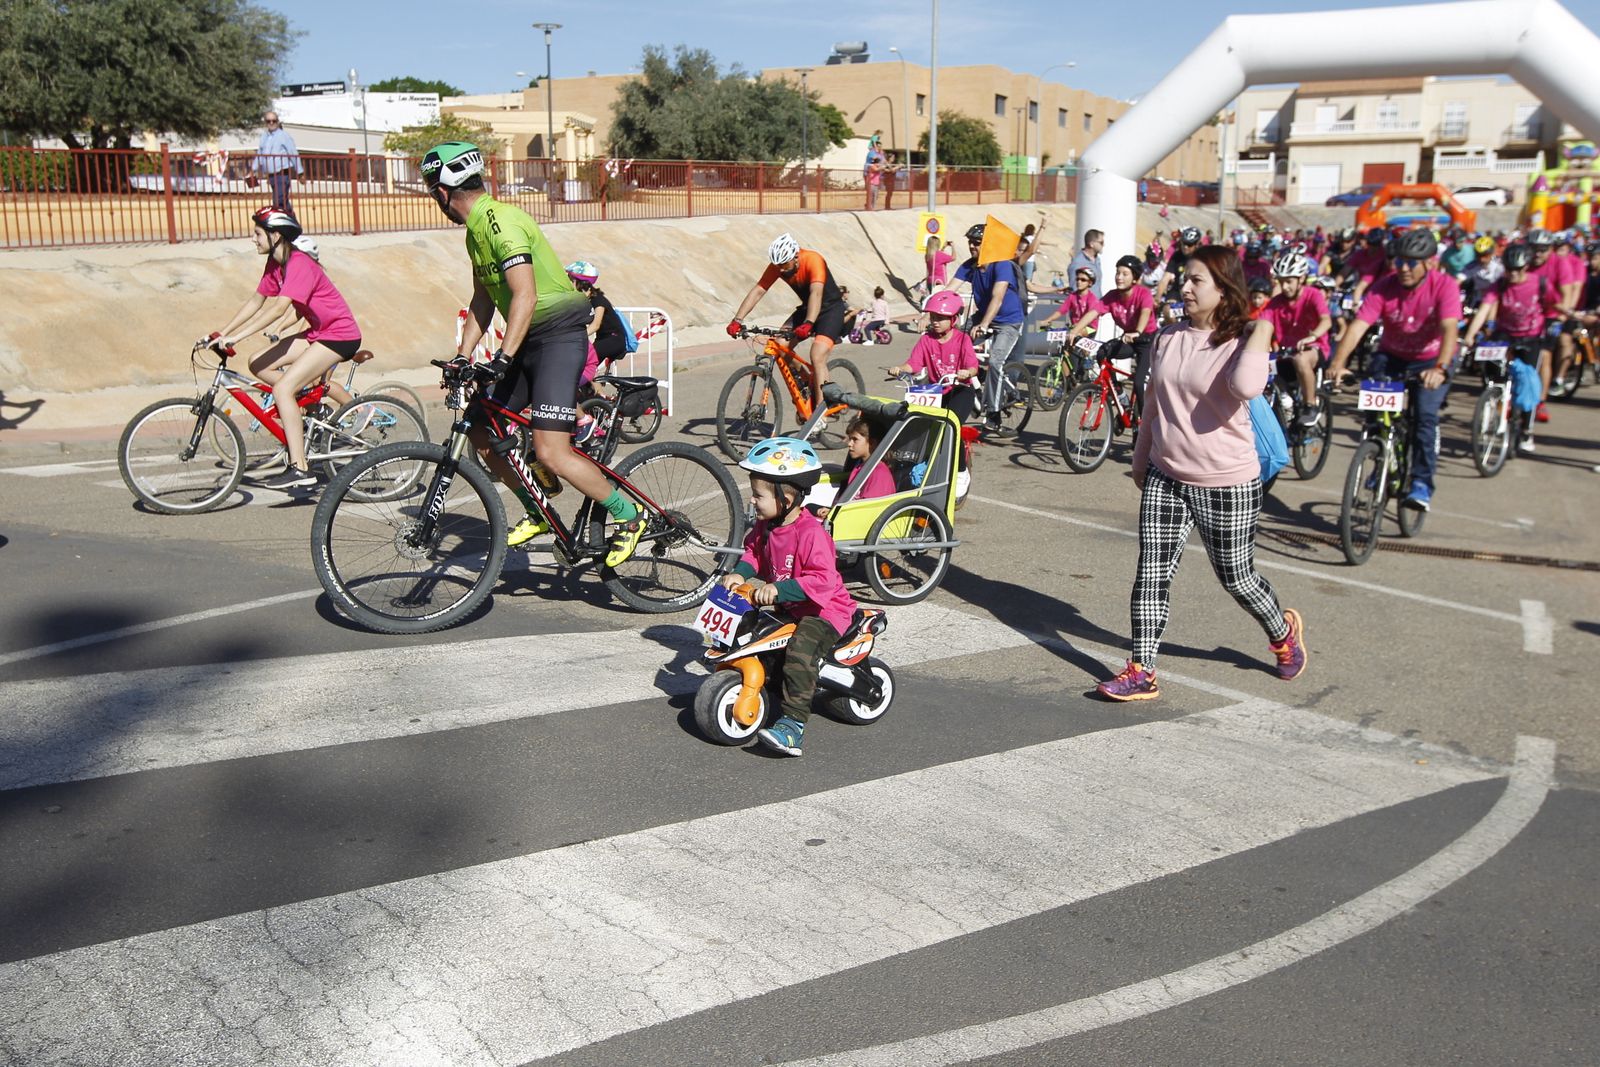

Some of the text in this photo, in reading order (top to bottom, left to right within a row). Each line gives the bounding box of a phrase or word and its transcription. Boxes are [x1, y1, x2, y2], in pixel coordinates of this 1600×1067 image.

[1079, 339, 1098, 351] 280
[910, 394, 937, 407] 207
[1363, 393, 1396, 408] 304
[533, 410, 557, 419] CIUDAD
[540, 404, 560, 412] CLUB
[428, 485, 449, 520] FOX
[700, 606, 733, 639] 494
